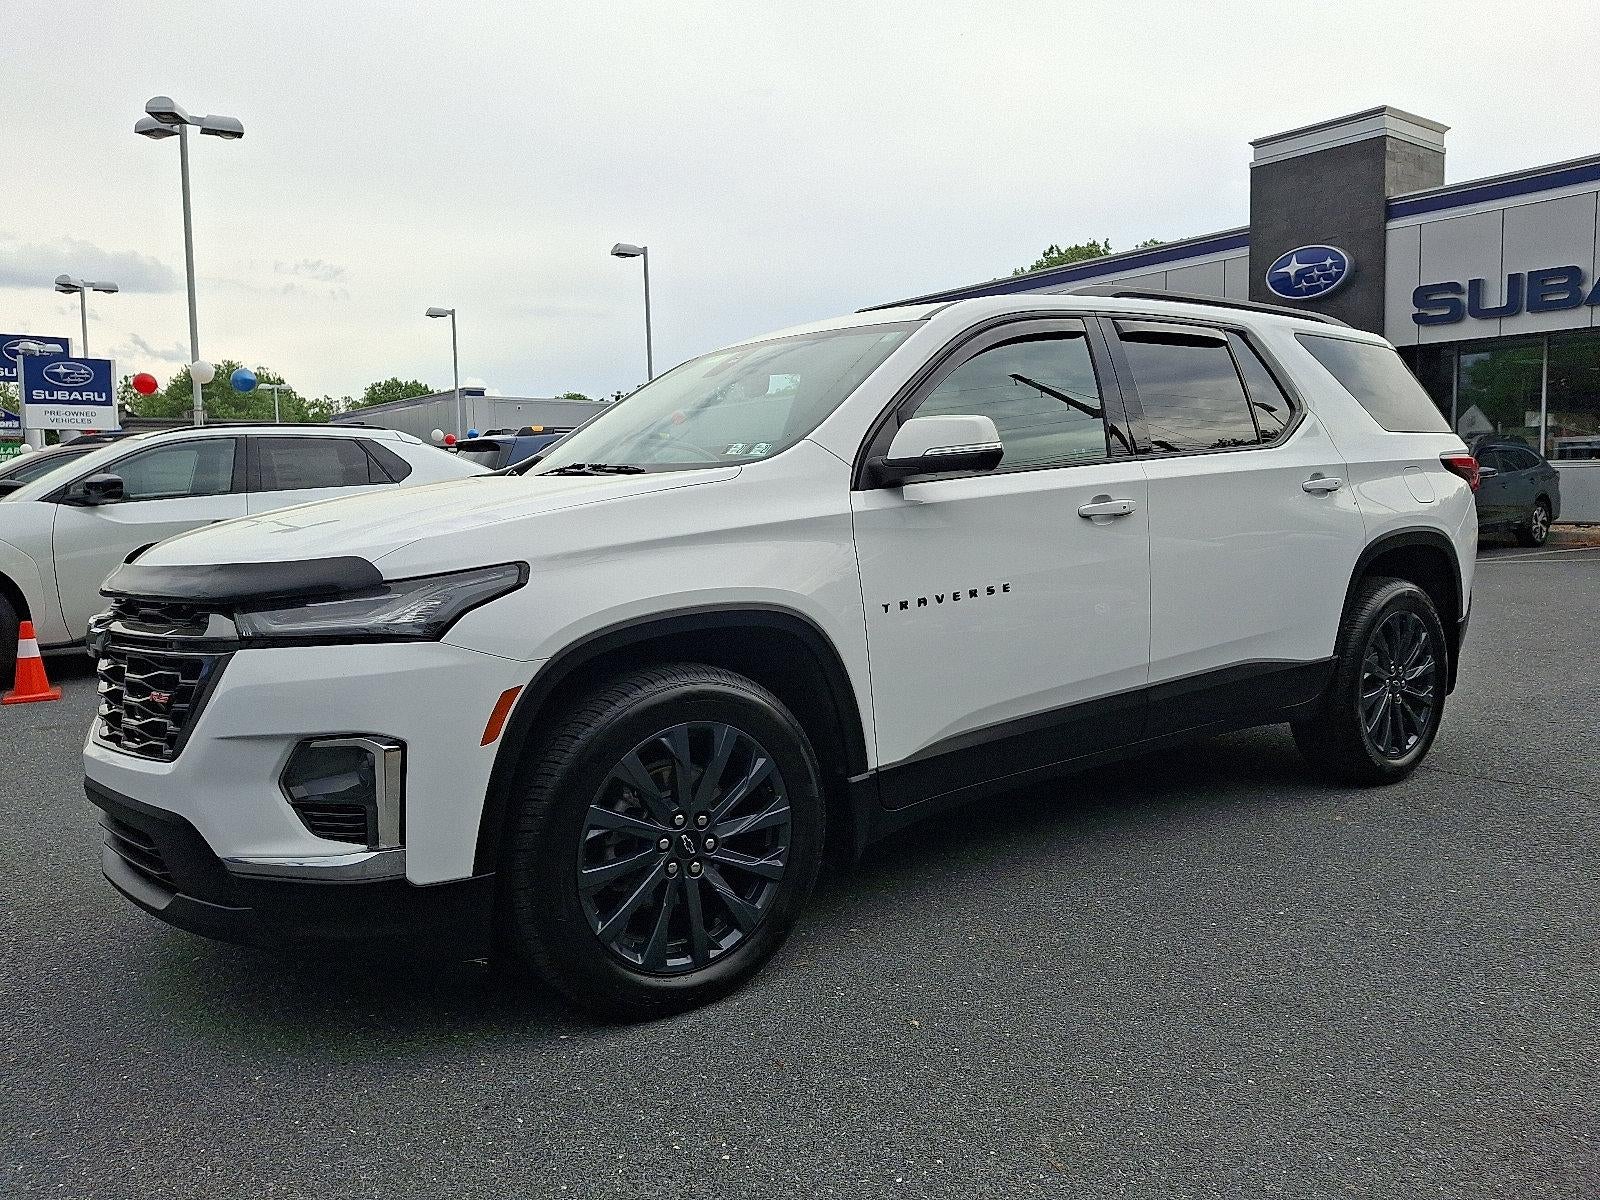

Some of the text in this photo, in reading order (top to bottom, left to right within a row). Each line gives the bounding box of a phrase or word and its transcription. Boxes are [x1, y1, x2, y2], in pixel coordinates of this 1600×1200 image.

[1411, 265, 1600, 326] SUB
[32, 389, 107, 402] SUBARU
[44, 410, 97, 418] PRE-OWNED
[49, 417, 92, 425] VEHICLES
[881, 582, 1011, 614] TRAVERSE
[149, 691, 171, 703] RS
